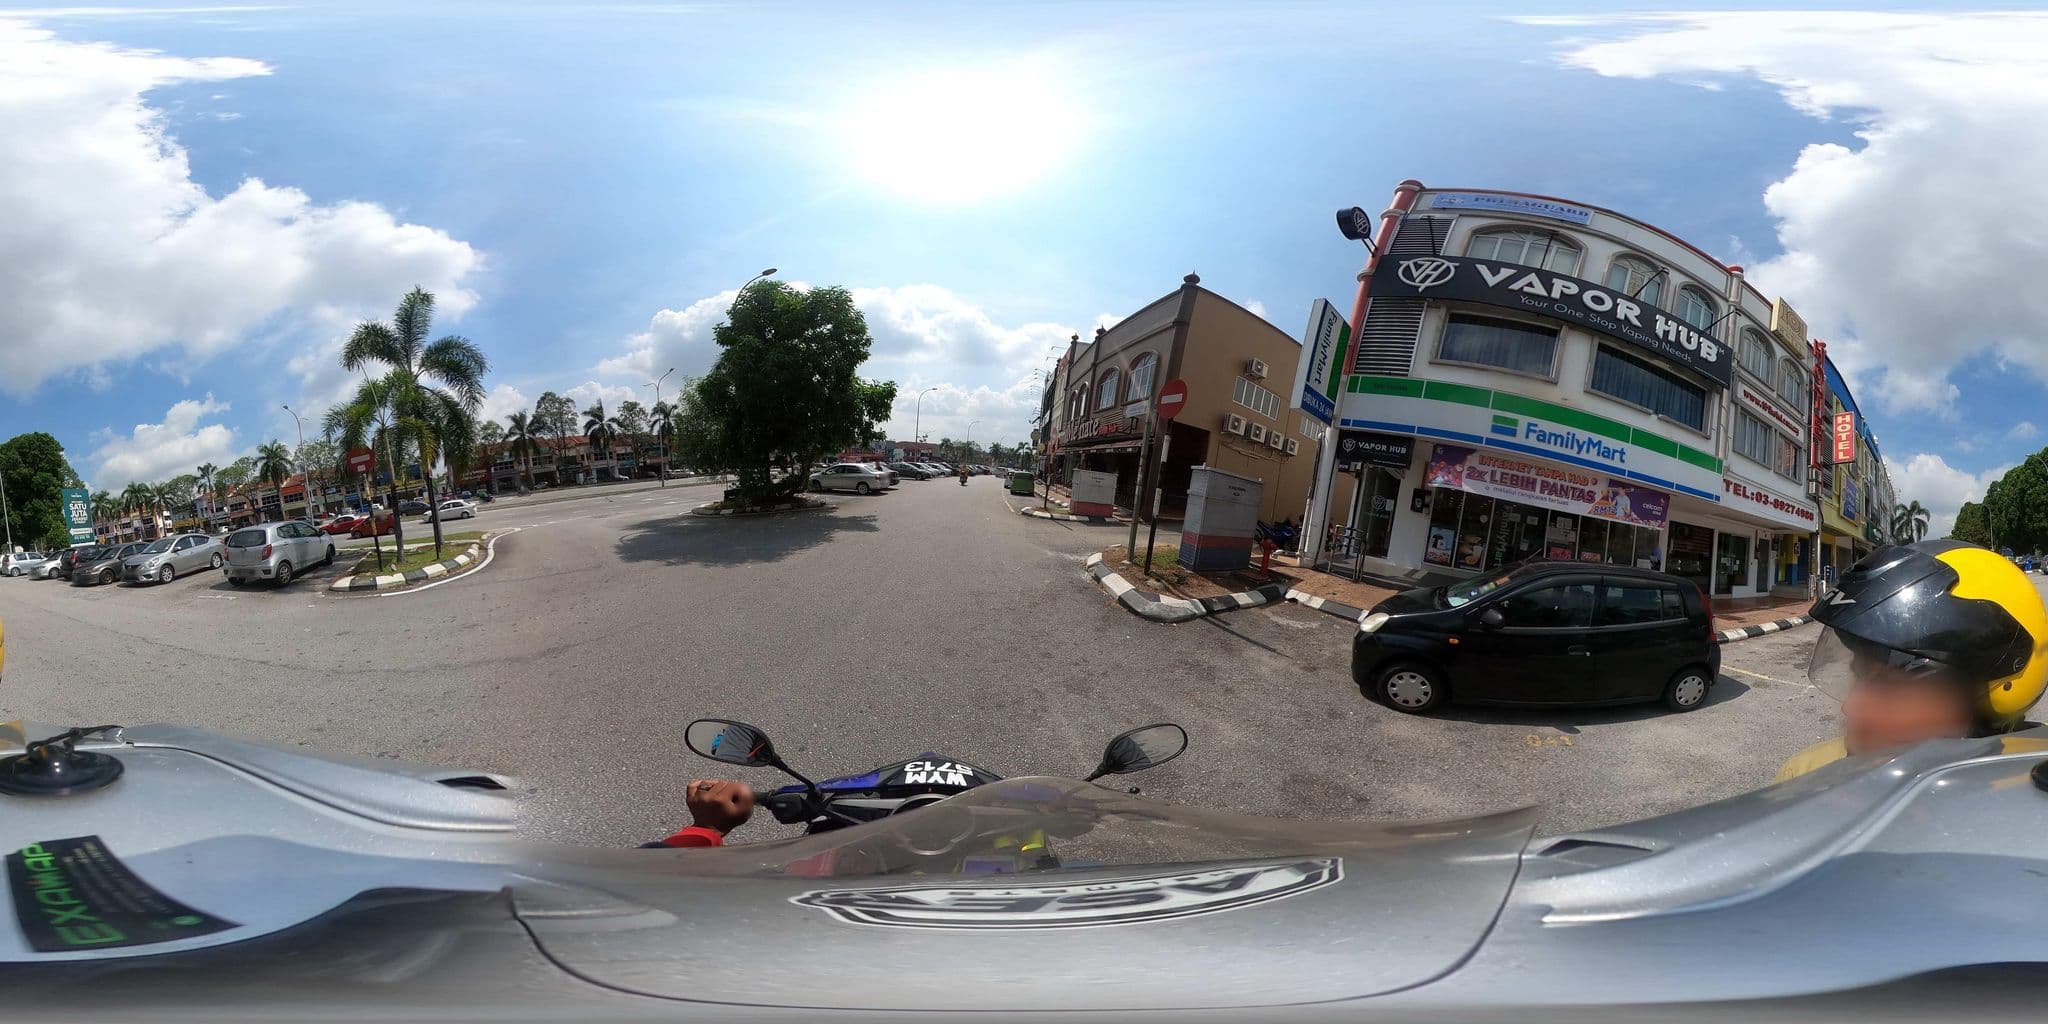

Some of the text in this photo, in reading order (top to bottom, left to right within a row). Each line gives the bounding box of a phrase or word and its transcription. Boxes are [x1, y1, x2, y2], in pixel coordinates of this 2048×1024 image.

[1474, 263, 1643, 327] VAPOR
[1655, 313, 1719, 362] HUB
[1520, 295, 1693, 364] Your One Stop Vaping Needs
[1314, 311, 1337, 385] FamilyMart
[1358, 441, 1387, 452] VAPOR
[1389, 446, 1407, 454] HUB
[1525, 421, 1626, 463] FamilyMart
[1837, 415, 1850, 460] HOTEL
[1478, 454, 1534, 475] INTERNET
[1489, 469, 1538, 493] LEBIH
[1540, 480, 1598, 504] PANTAS
[70, 510, 88, 518] JUTA
[904, 762, 974, 777] 5713
[905, 771, 968, 787] WYM
